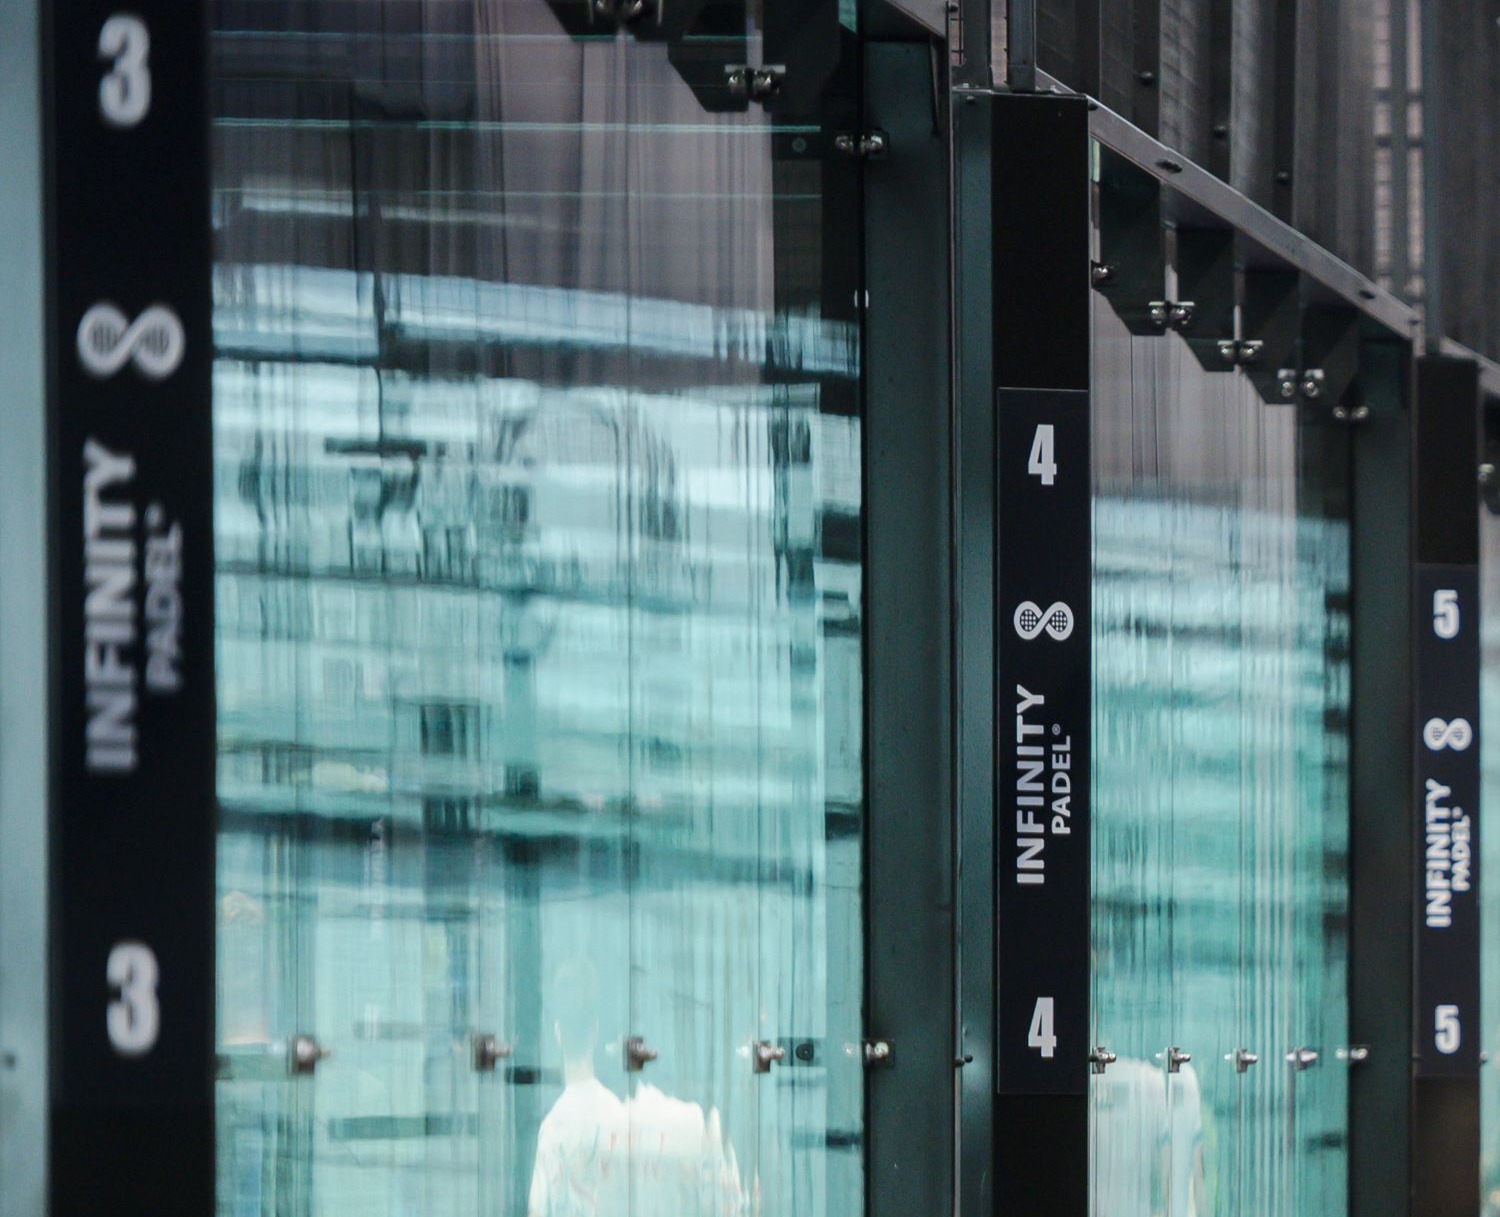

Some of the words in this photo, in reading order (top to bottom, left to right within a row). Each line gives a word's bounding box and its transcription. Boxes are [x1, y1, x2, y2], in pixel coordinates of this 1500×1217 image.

[99, 15, 152, 125] 3
[1028, 423, 1057, 485] 4
[84, 439, 136, 769] INFINITY
[1433, 589, 1460, 639] 5
[1016, 684, 1045, 884] INFINITY
[1425, 778, 1451, 927] INFINITY
[107, 943, 159, 1053] 3
[1028, 997, 1056, 1057] 4
[1435, 1004, 1460, 1054] 5
